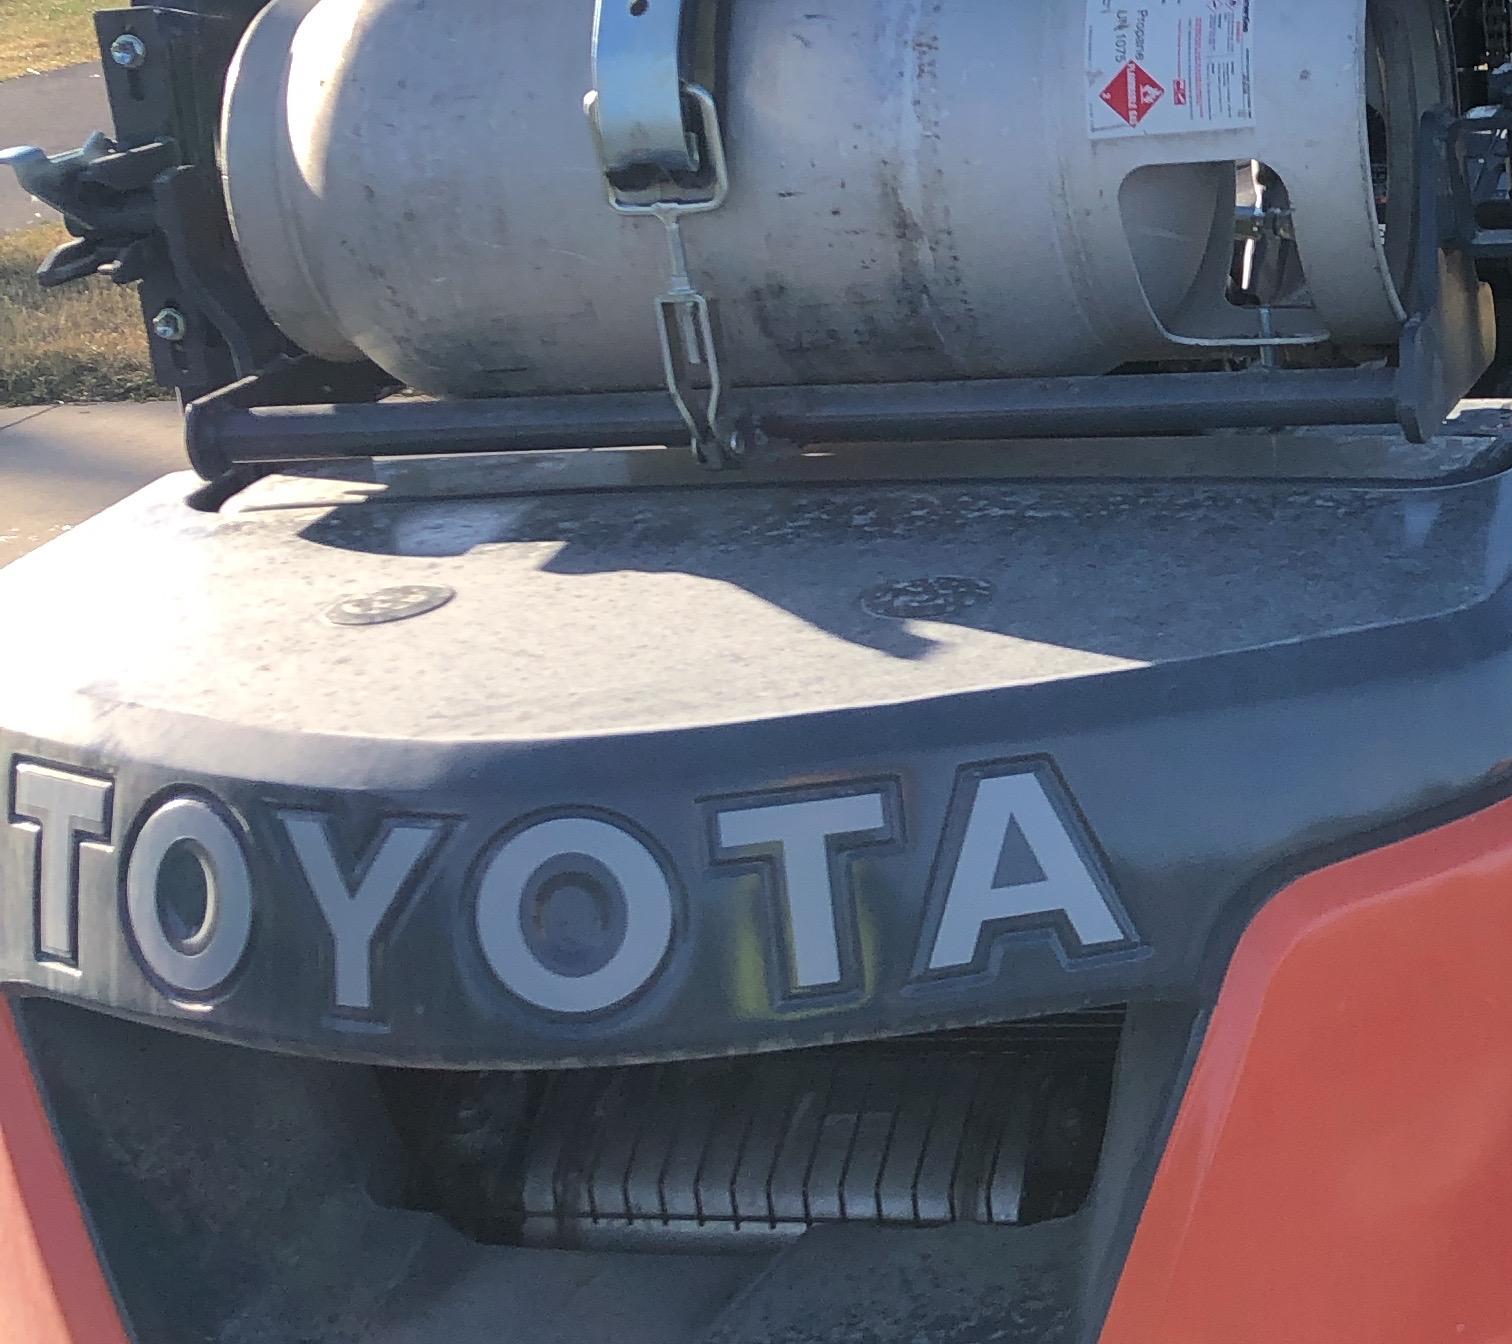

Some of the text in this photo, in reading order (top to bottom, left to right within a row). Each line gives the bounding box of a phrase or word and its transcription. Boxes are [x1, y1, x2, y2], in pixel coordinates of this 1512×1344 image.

[1114, 32, 1128, 63] 1075
[1134, 9, 1149, 61] Propane
[10, 758, 1142, 1018] TOYOTA
